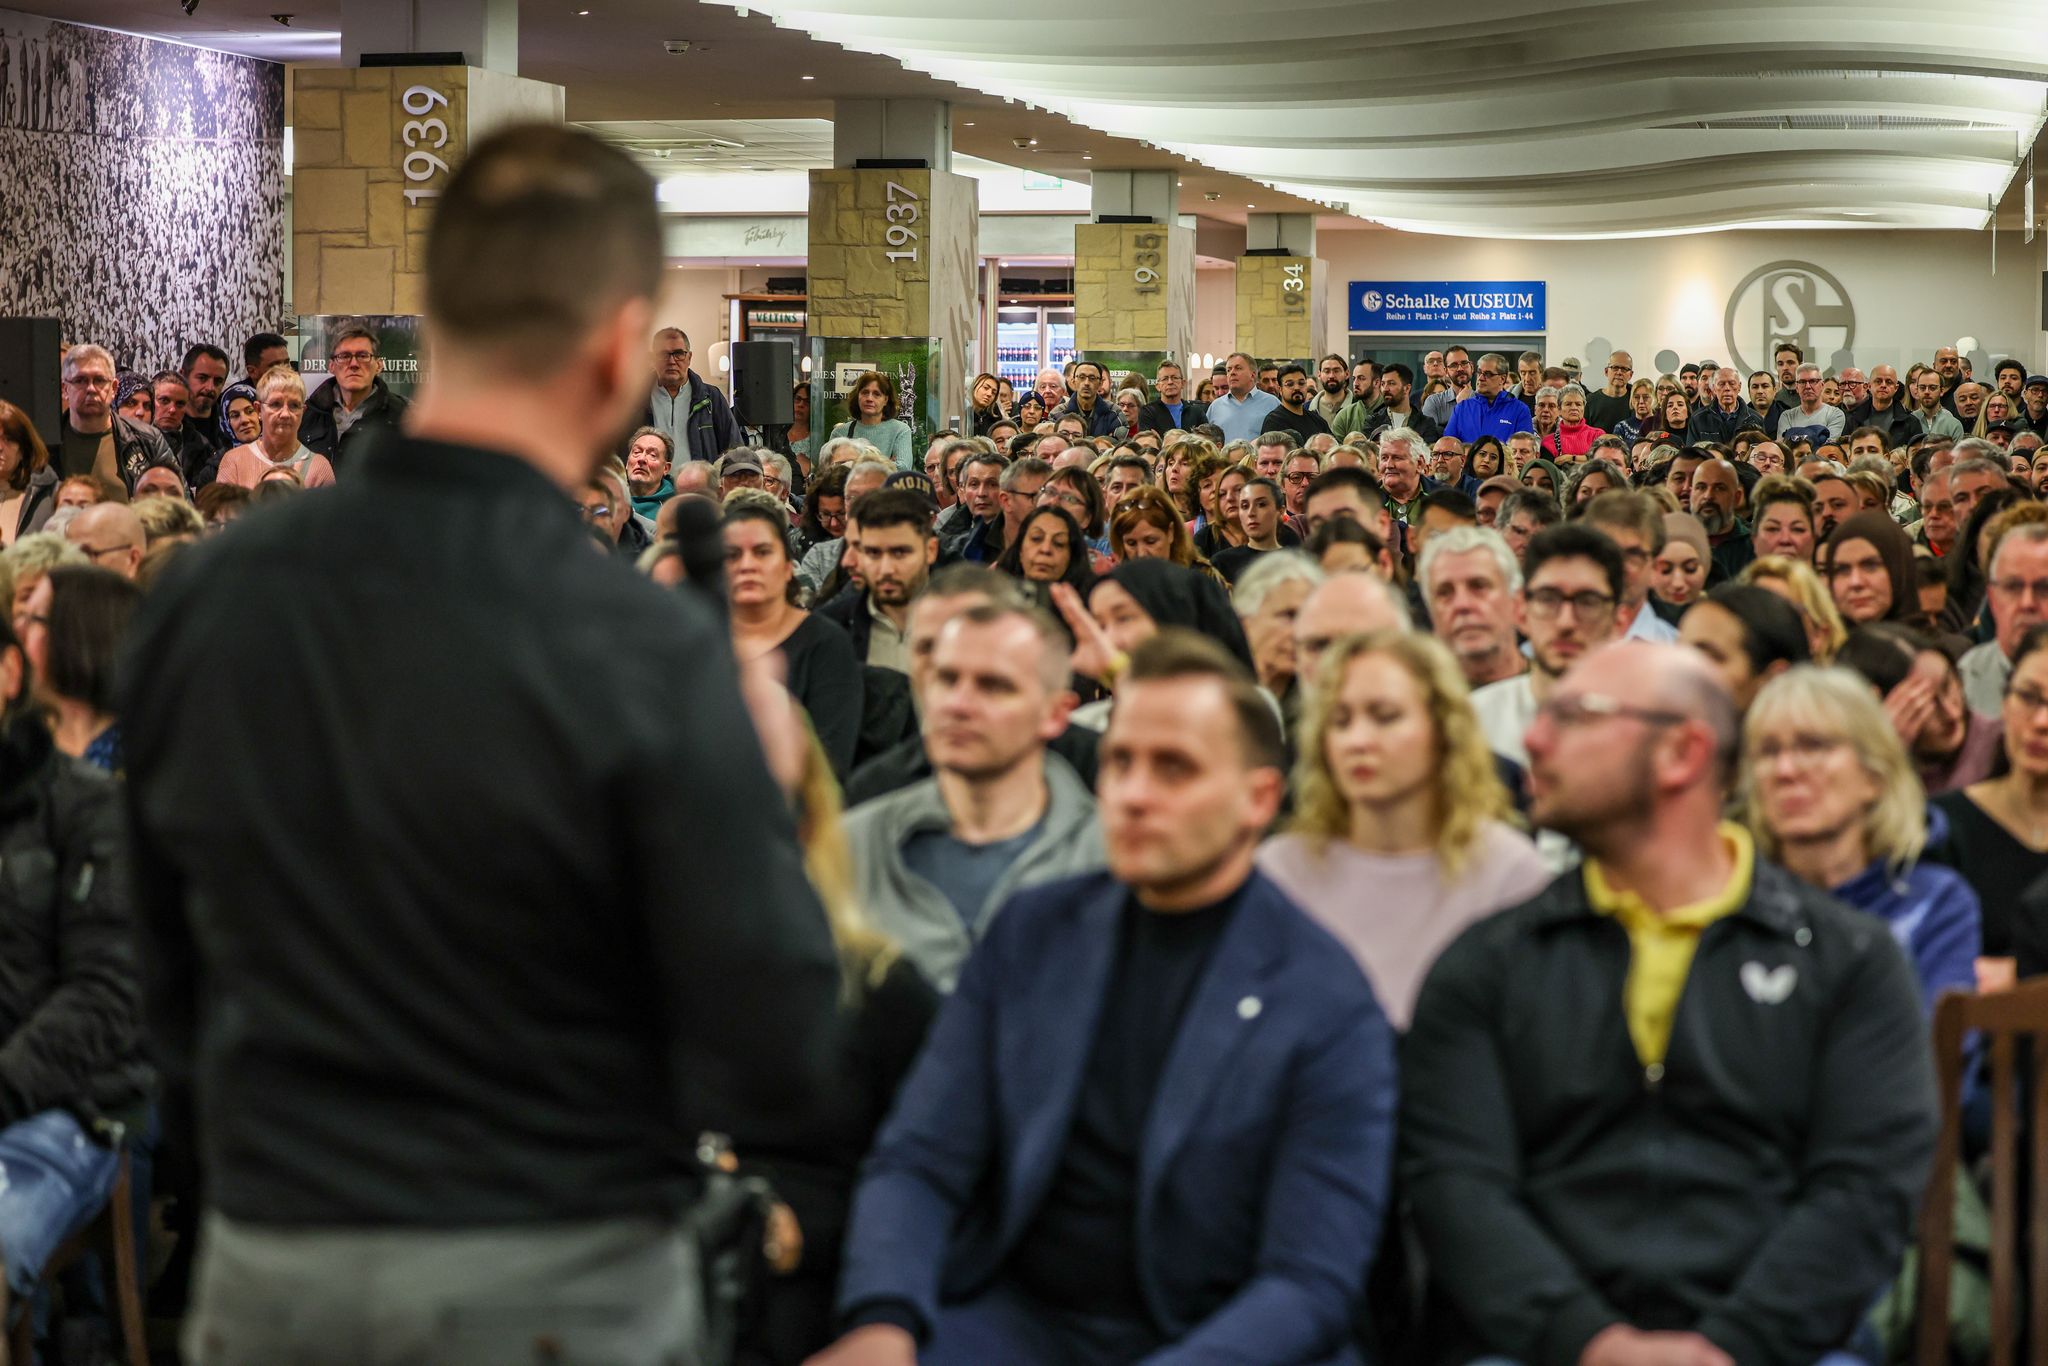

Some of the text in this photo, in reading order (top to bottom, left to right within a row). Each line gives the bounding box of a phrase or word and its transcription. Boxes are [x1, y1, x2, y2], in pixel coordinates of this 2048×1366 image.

[402, 85, 449, 206] 1939
[885, 181, 918, 263] 1937
[1134, 233, 1161, 296] 1935
[1283, 263, 1305, 316] 1934
[1386, 294, 1450, 309] Schalke
[1454, 293, 1534, 309] MUSEUM
[756, 312, 798, 323] VELTINS
[1386, 312, 1406, 320] Reihe
[1415, 312, 1432, 320] Platz
[1453, 312, 1467, 320] und
[1470, 312, 1490, 320] Reihe
[1491, 312, 1496, 320] 2
[1499, 312, 1516, 320] Platz
[304, 359, 327, 371] DER
[892, 476, 931, 495] MOIN
